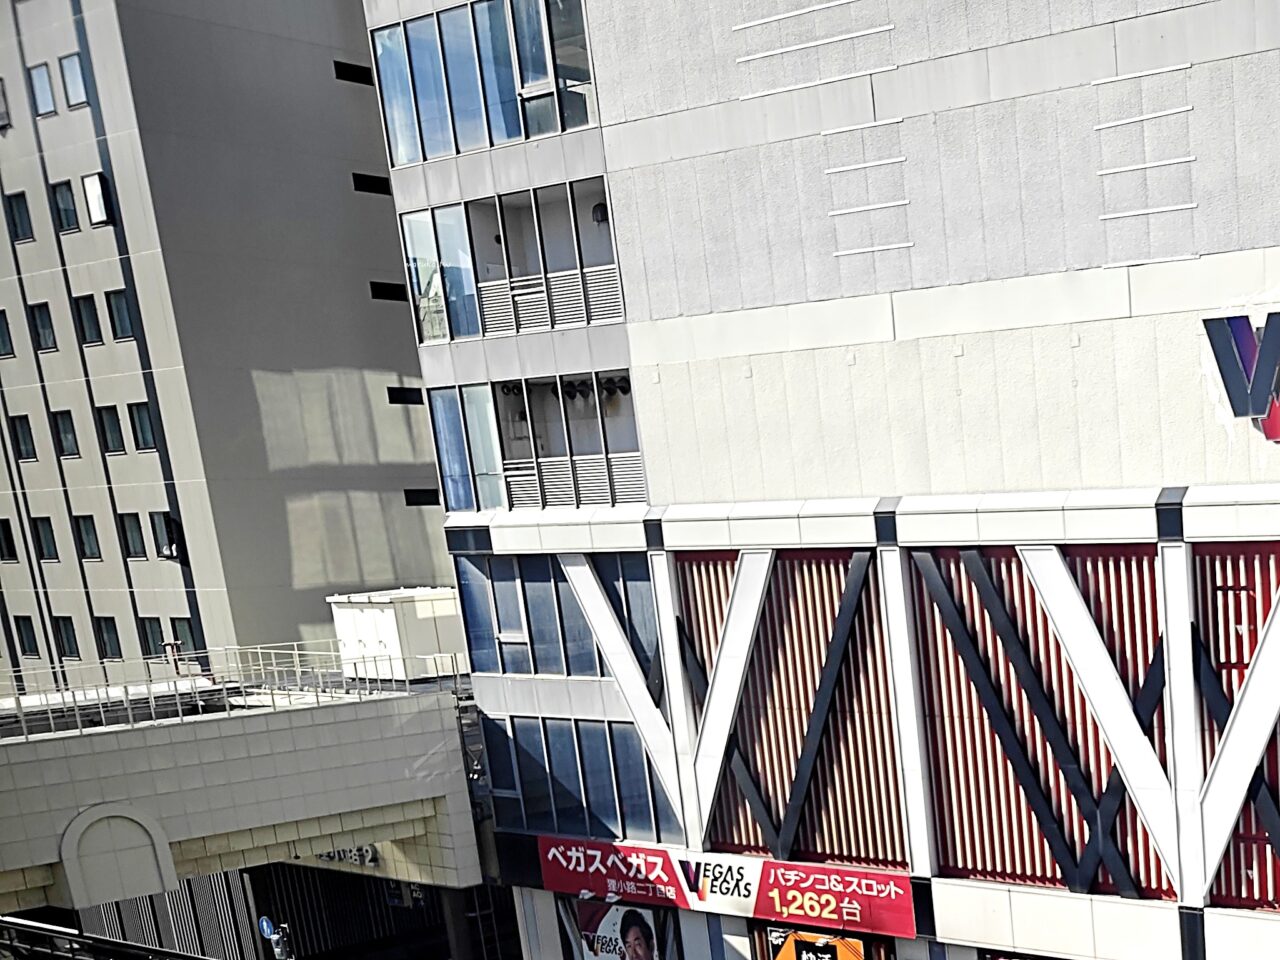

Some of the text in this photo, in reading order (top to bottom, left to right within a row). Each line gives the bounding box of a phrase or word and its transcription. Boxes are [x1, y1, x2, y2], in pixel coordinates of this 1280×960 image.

[547, 845, 669, 883] ベガスベガス
[678, 859, 745, 893] VEGAS
[698, 876, 752, 902] VEGAS
[582, 932, 620, 953] VEGAS
